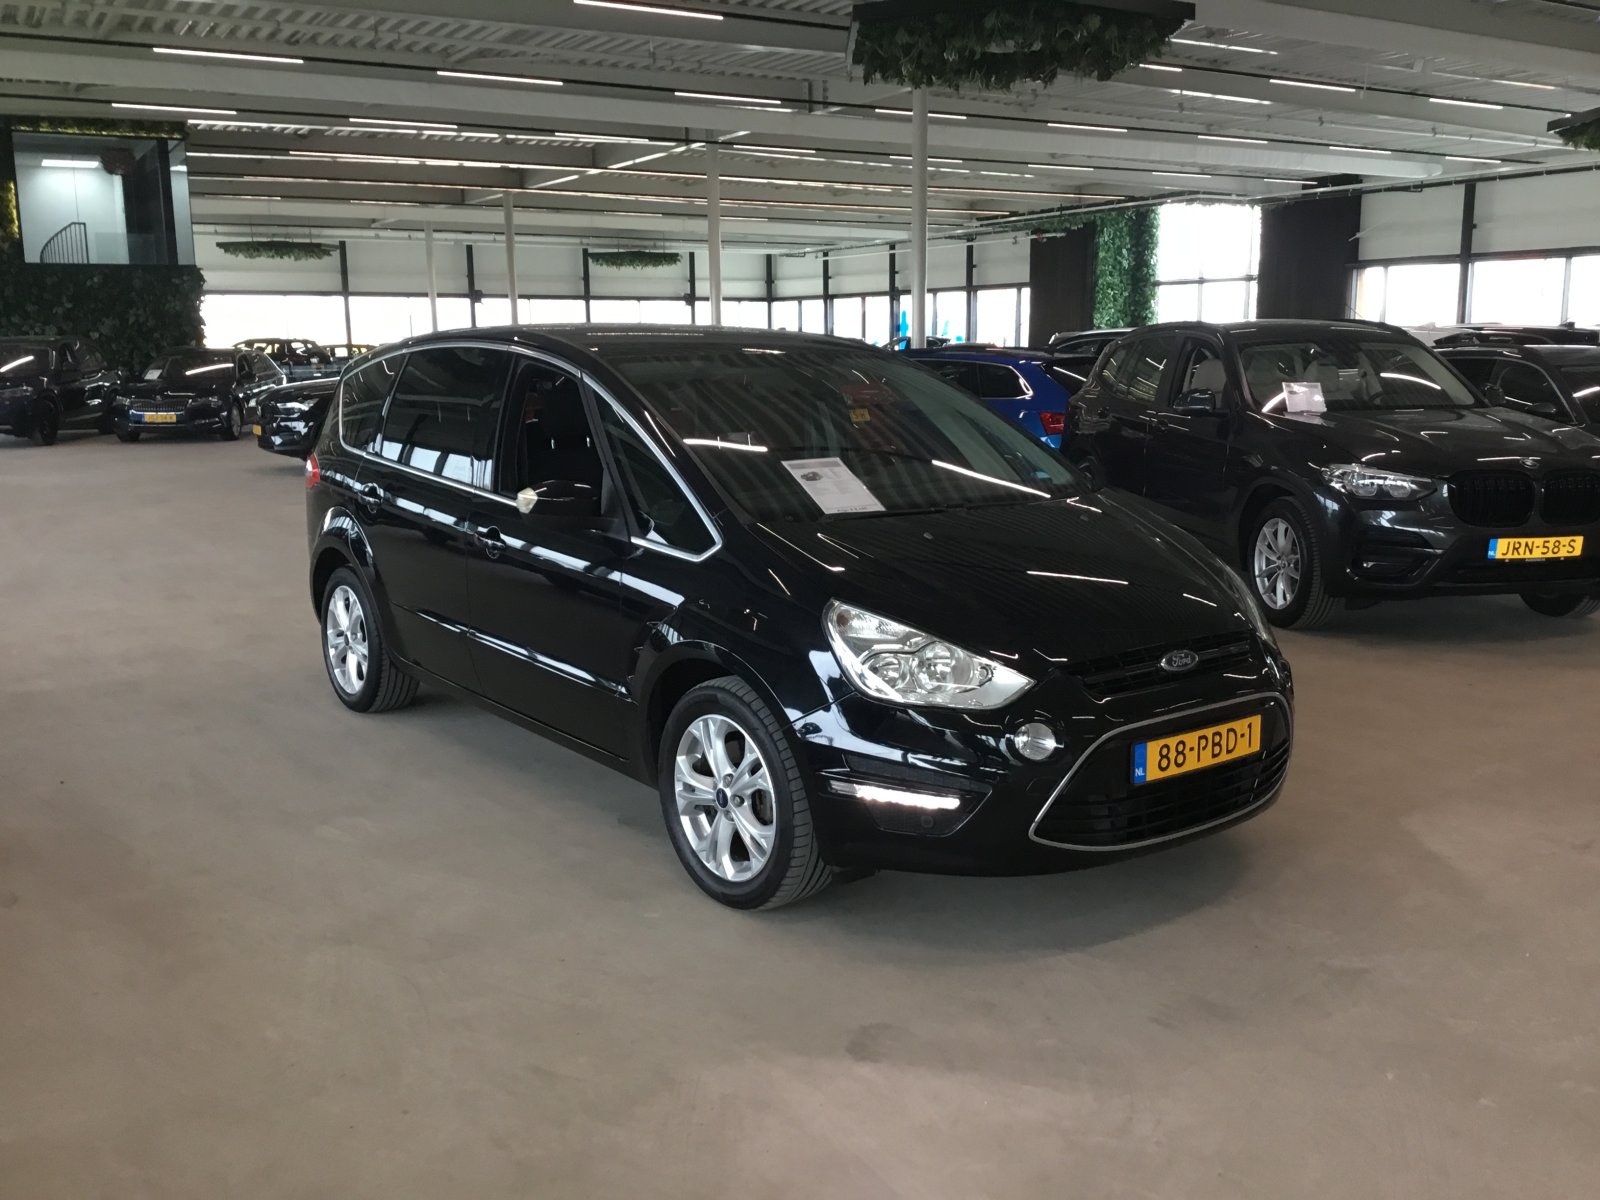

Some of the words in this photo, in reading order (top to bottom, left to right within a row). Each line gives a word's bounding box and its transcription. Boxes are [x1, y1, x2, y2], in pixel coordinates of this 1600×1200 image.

[1501, 539, 1577, 556] JRN-58-S
[1171, 653, 1192, 667] Ford
[1157, 721, 1253, 772] 88-PBD-1
[1134, 767, 1145, 777] NL
